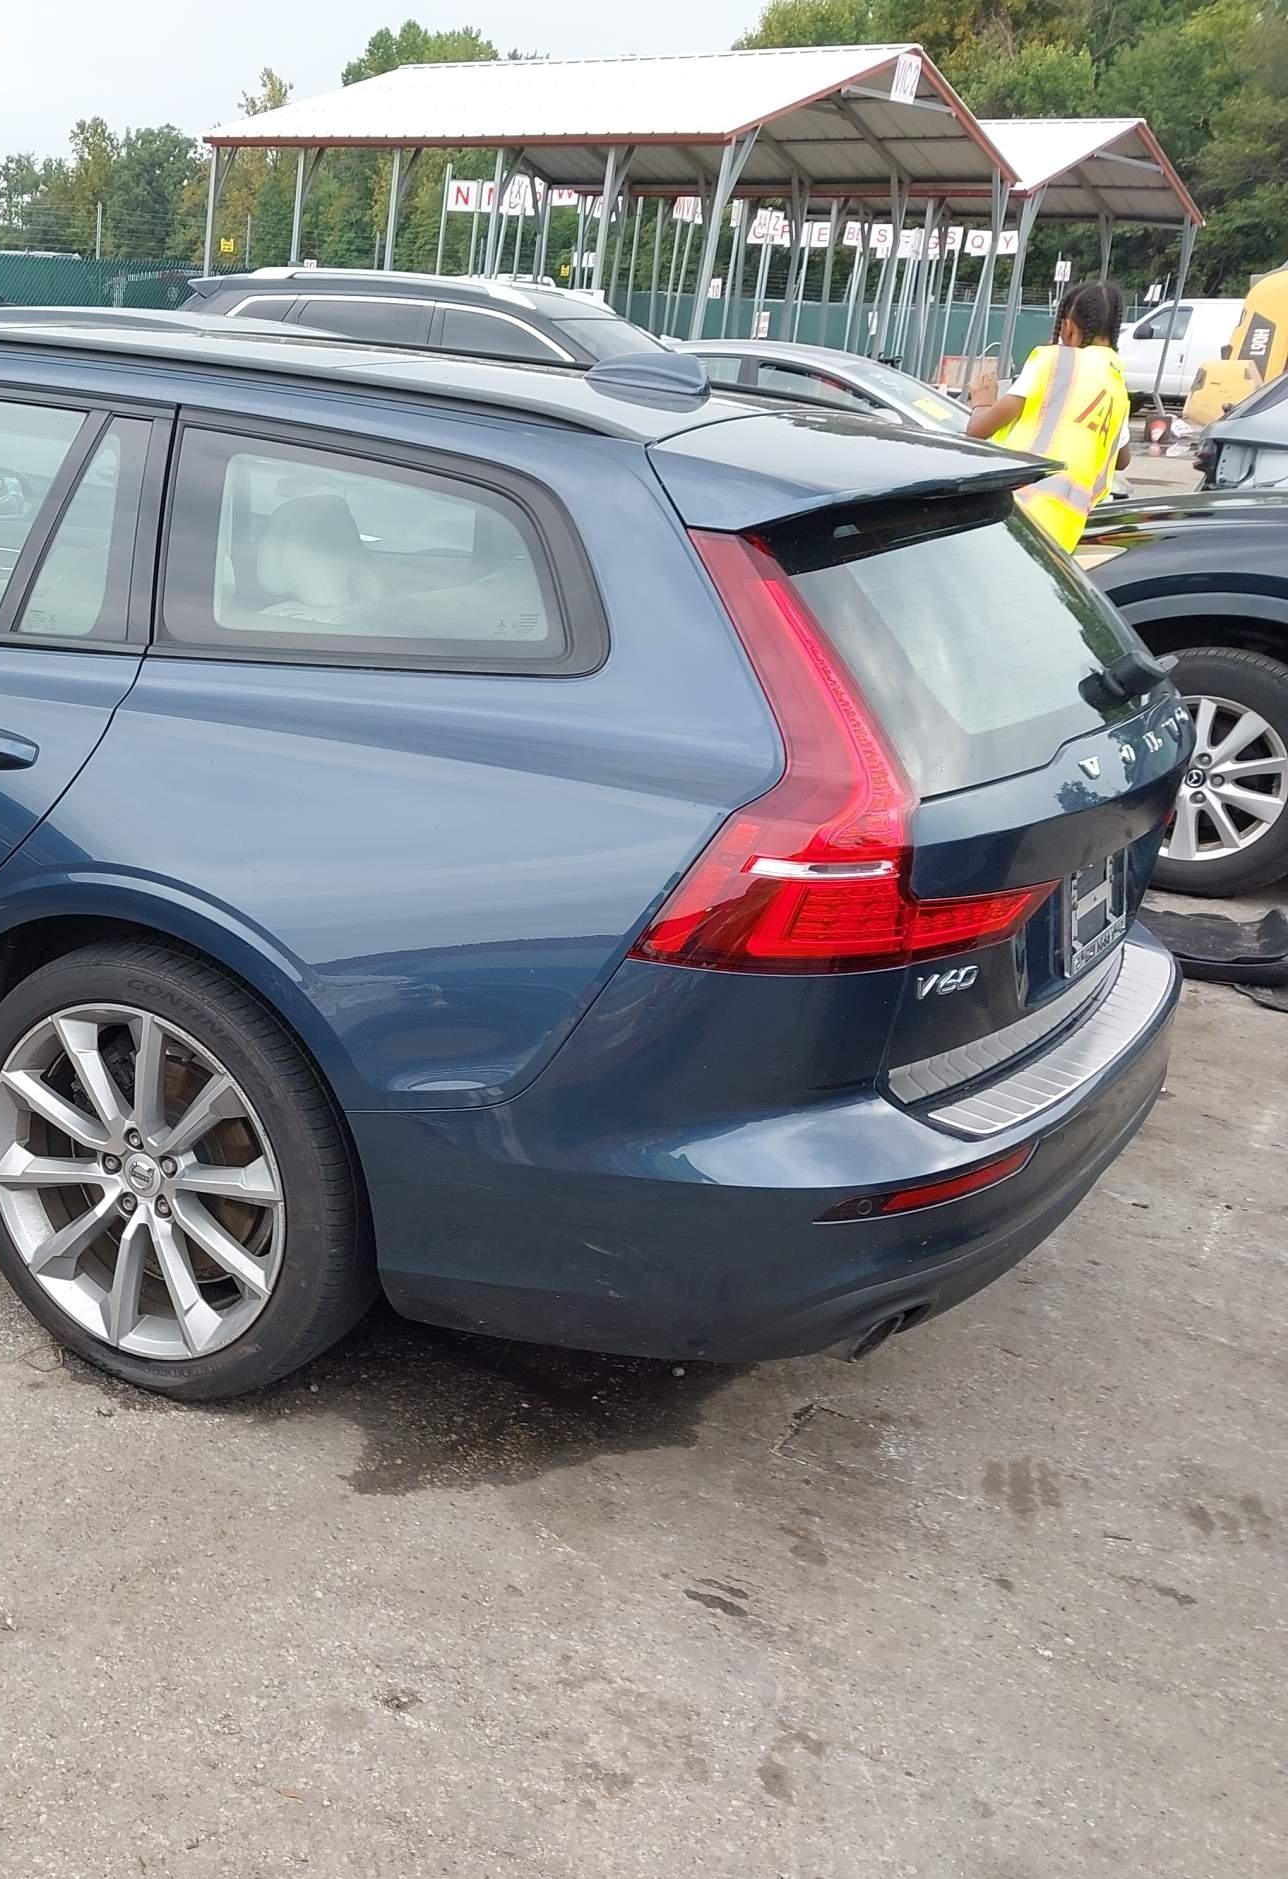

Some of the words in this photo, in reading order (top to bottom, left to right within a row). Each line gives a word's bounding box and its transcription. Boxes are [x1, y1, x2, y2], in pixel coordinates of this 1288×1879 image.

[455, 187, 470, 205] N
[818, 227, 828, 241] E
[876, 229, 888, 242] S
[972, 235, 984, 248] Q
[1003, 236, 1014, 248] Y
[1250, 328, 1271, 355] L90H
[917, 966, 979, 1000] V60
